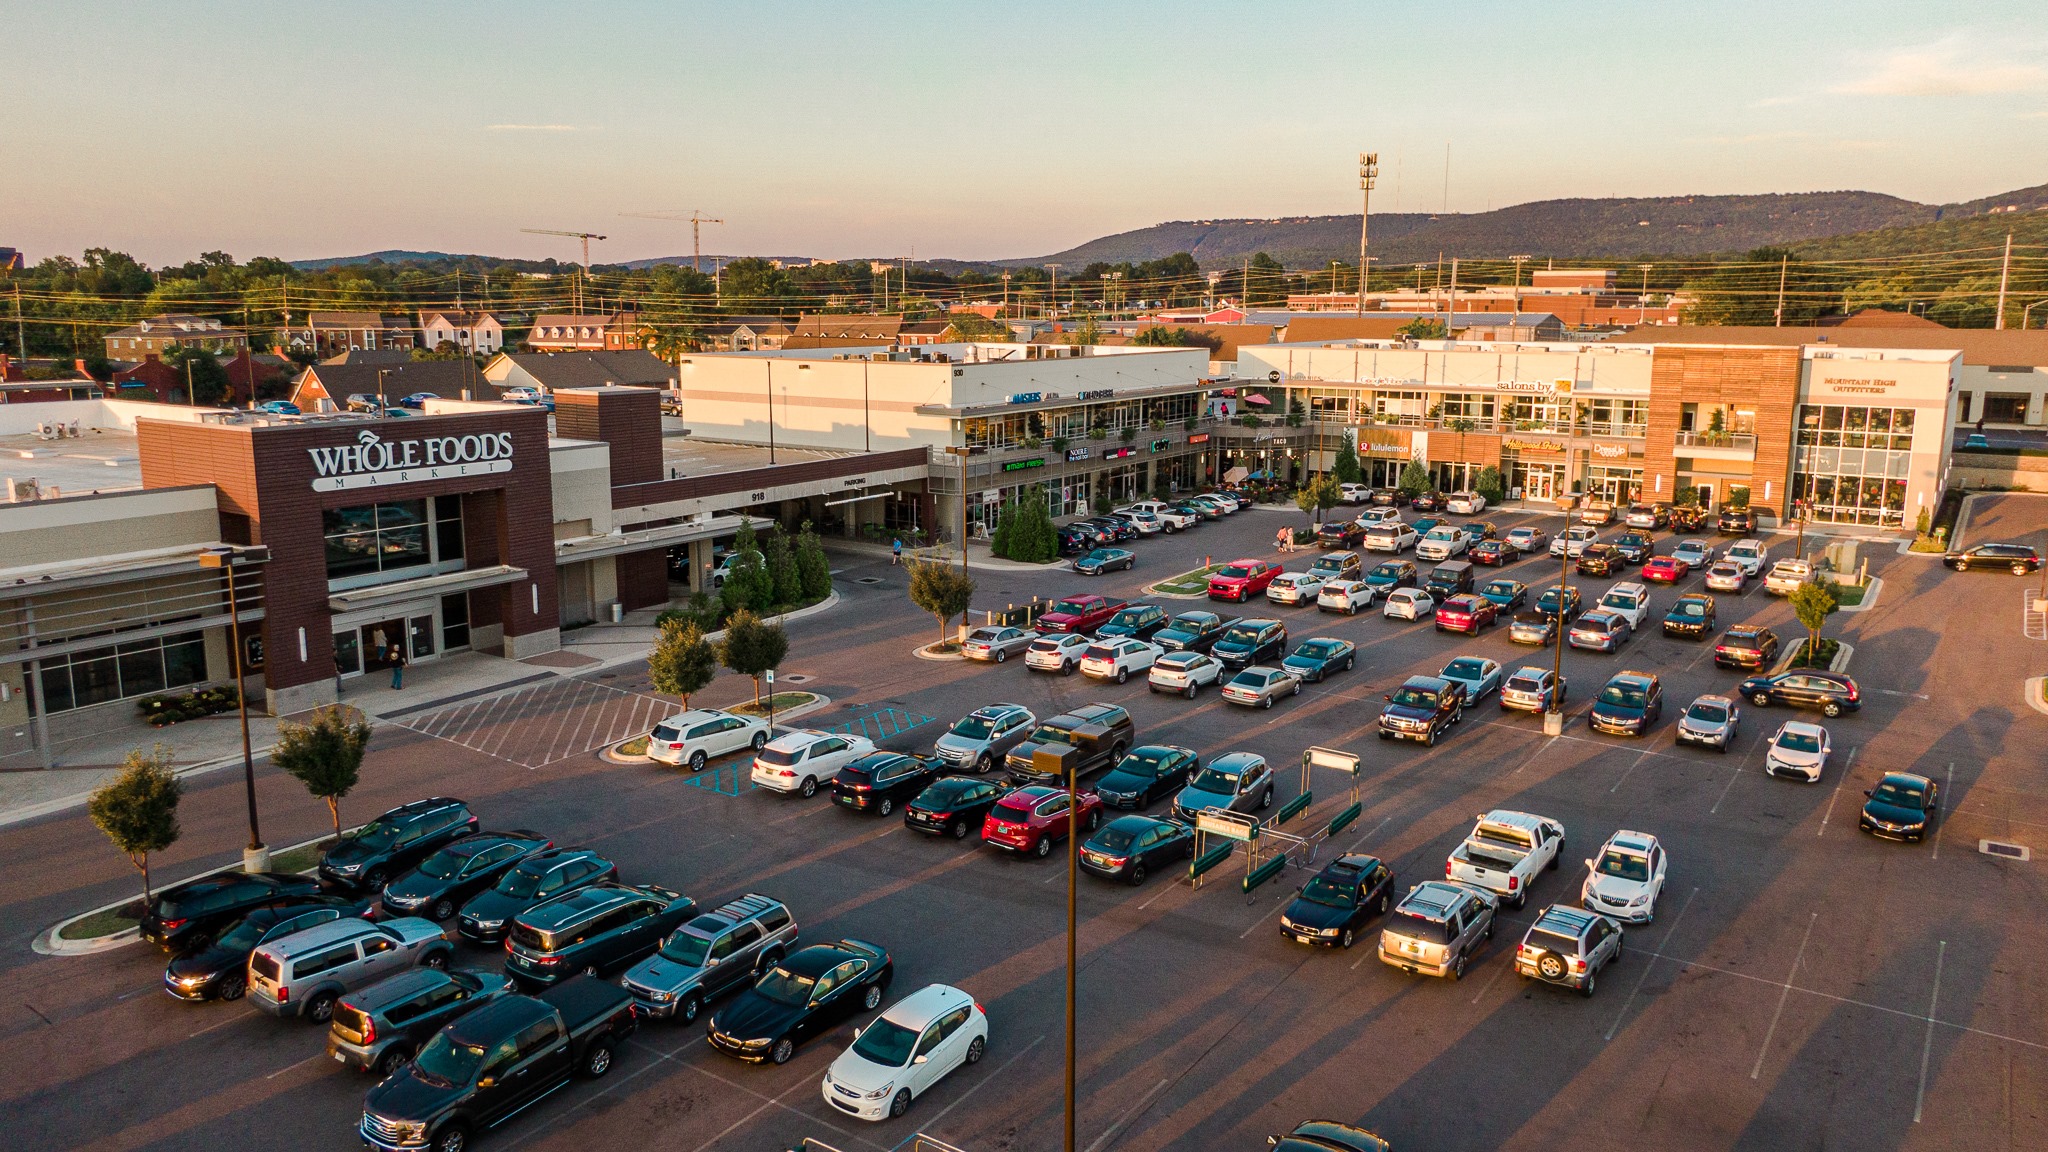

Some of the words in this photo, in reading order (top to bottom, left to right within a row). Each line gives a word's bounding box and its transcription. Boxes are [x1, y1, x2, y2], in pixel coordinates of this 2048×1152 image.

[953, 368, 964, 377] 930
[1823, 377, 1871, 386] MOUNTAIN
[1872, 379, 1897, 387] HIGH
[1496, 380, 1536, 392] salons
[1537, 381, 1557, 401] by
[1832, 385, 1886, 394] OUTFITTERS
[1371, 443, 1409, 453] lululemon
[306, 430, 422, 477] WHOLE
[424, 431, 514, 465] FOODS
[334, 462, 495, 489] MARKET
[843, 477, 867, 487] PARKING
[751, 491, 765, 502] 918
